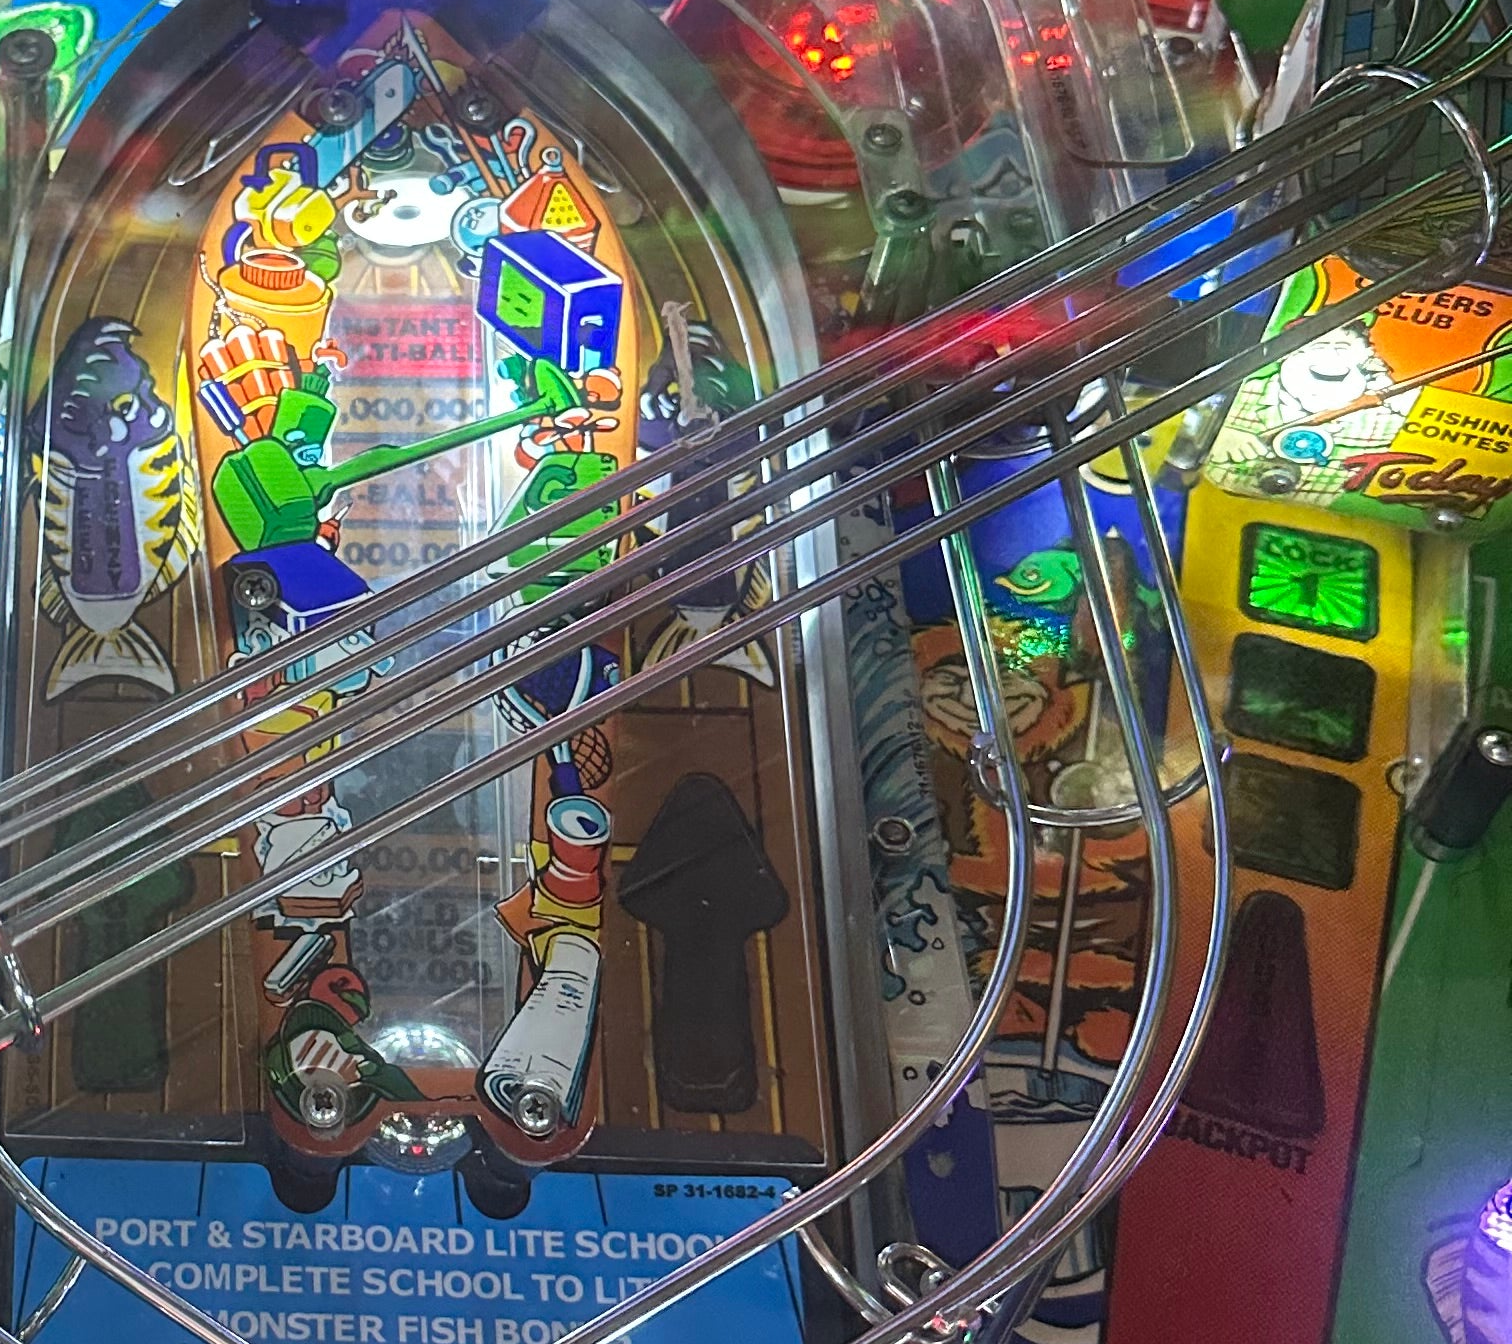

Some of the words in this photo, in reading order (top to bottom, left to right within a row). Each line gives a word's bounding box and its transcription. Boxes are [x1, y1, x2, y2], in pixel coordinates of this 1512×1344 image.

[1375, 302, 1454, 329] CLUB
[1402, 420, 1512, 454] CONTES
[1419, 407, 1512, 438] FISHIN
[653, 1183, 678, 1198] SP
[684, 1183, 776, 1199] 31-1682-4
[95, 1217, 197, 1249] PORT
[207, 1220, 232, 1249] &
[243, 1221, 474, 1256] STARBOARD
[487, 1229, 565, 1258] LITE
[575, 1232, 725, 1261] SCHOO
[148, 1261, 351, 1295] COMPLETE
[363, 1267, 524, 1301] SCHOOL
[531, 1274, 584, 1303] TO
[596, 1276, 660, 1305] LIT
